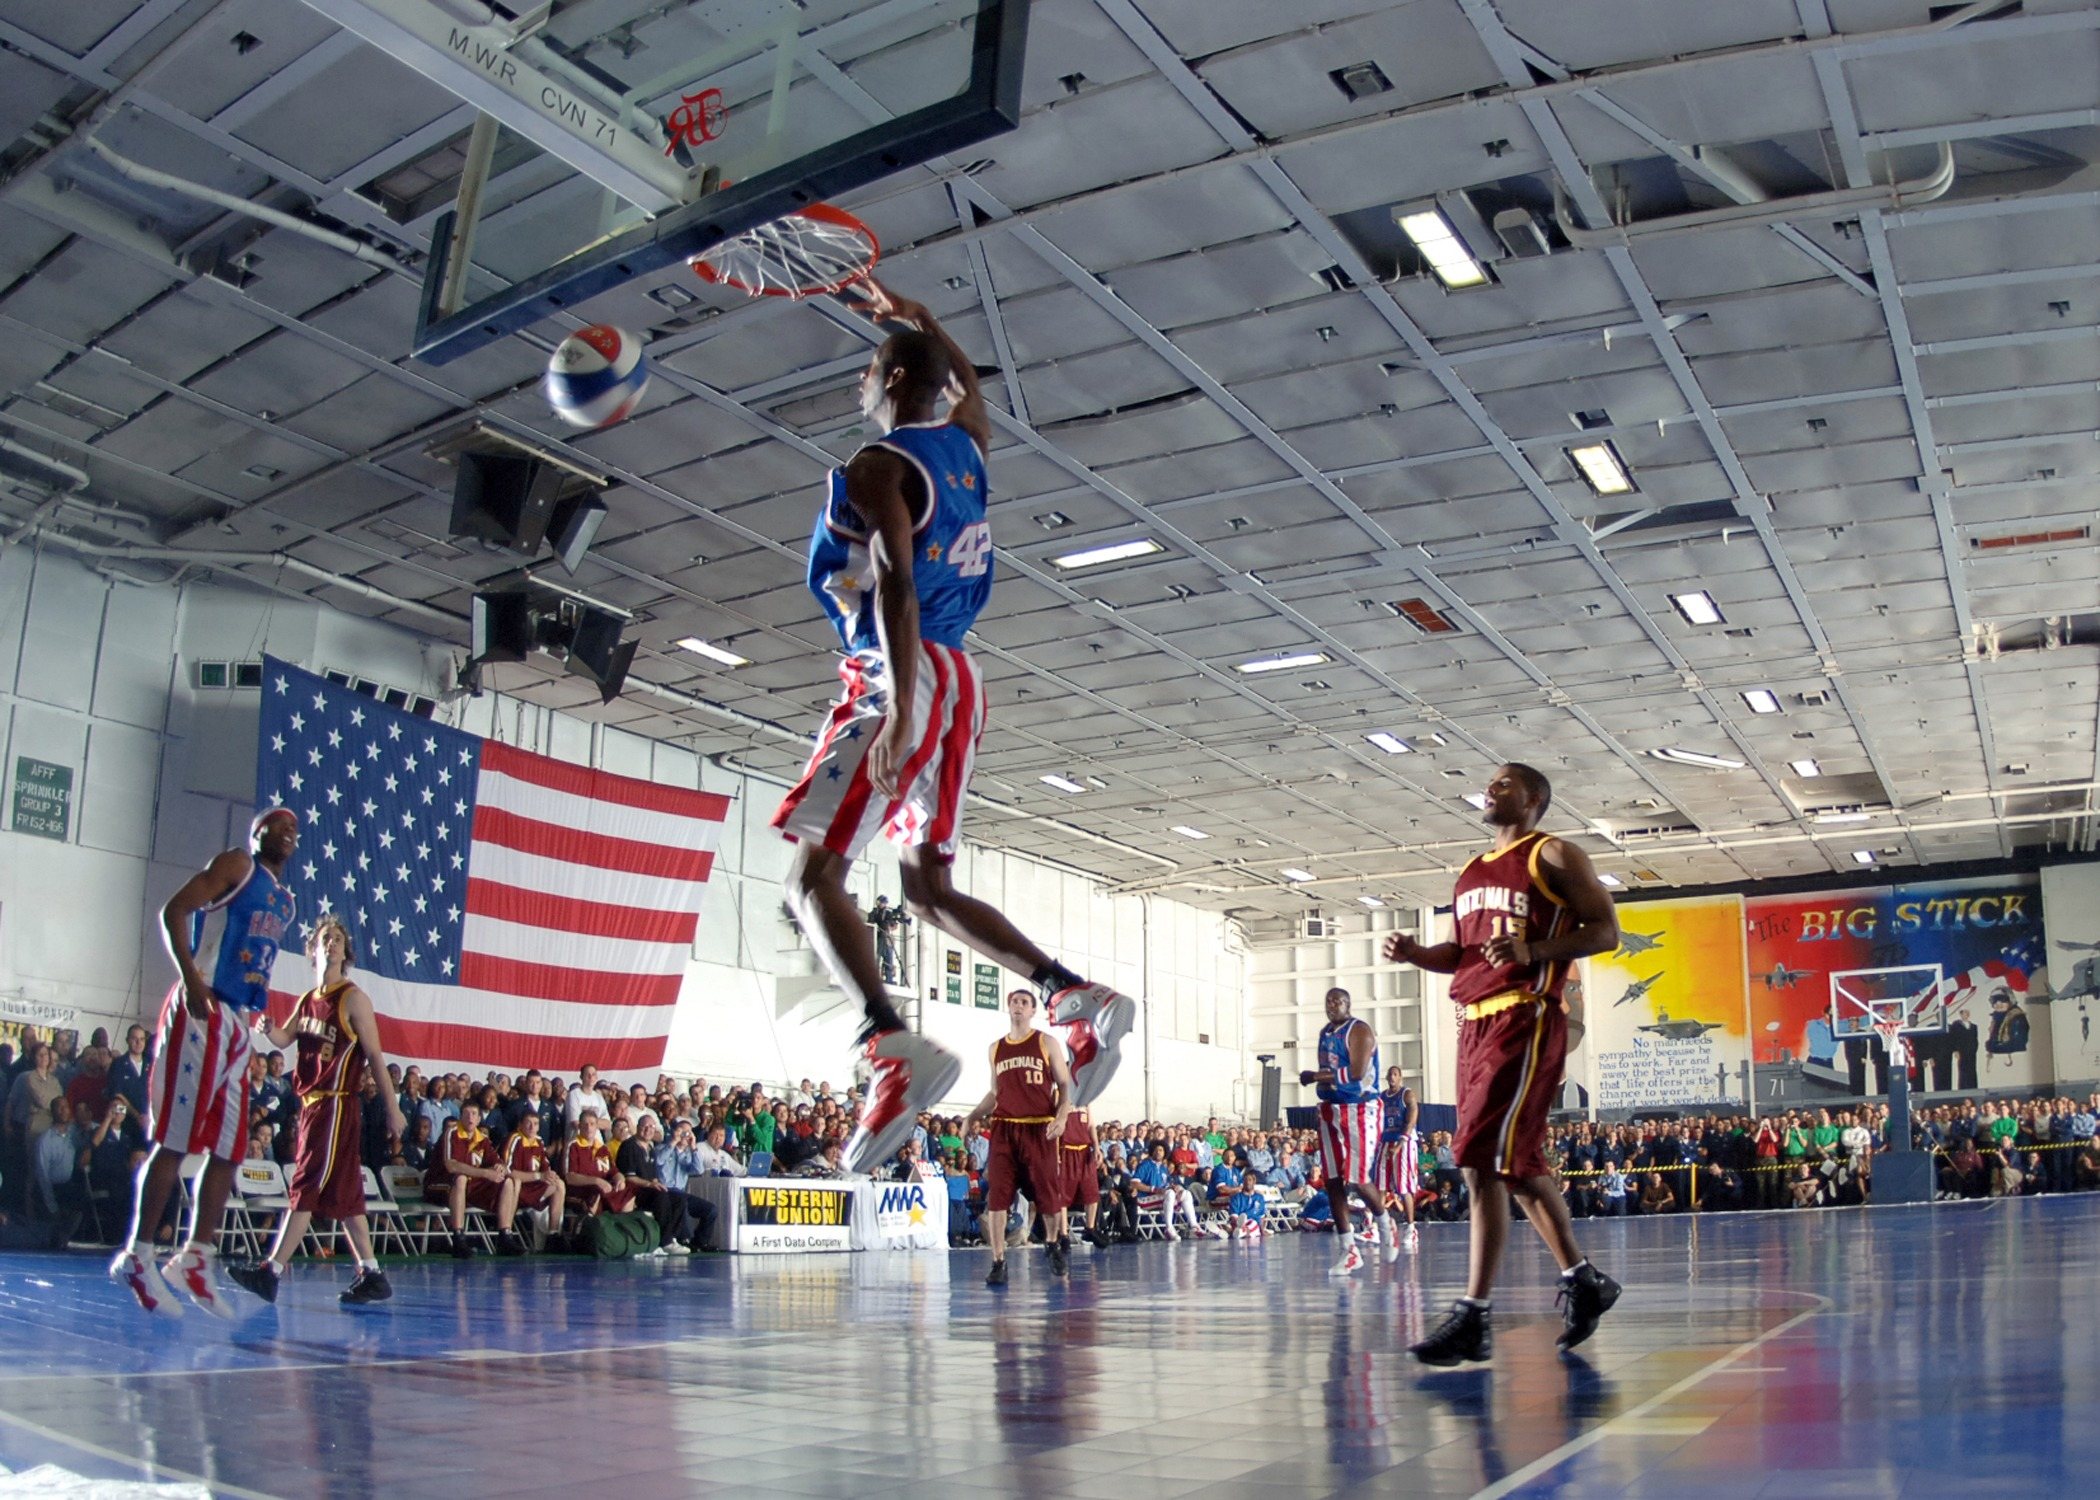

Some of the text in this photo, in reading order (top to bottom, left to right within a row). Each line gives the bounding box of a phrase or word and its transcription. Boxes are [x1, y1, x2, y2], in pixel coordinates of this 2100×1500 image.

[448, 28, 617, 146] M.W.R CVN 71
[947, 520, 992, 578] 42
[30, 764, 56, 779] AFFF
[21, 797, 62, 816] GROUP 3
[1754, 895, 2029, 942] The BIG STICK
[1491, 916, 1527, 944] 15
[1633, 1037, 1649, 1048] No
[1680, 1034, 1713, 1046] needs
[1599, 1046, 1711, 1062] sympathy because he
[1599, 1061, 1617, 1070] has
[1619, 1059, 1629, 1069] to
[1668, 1057, 1687, 1067] Far
[1690, 1056, 1710, 1065] and
[1025, 1070, 1044, 1085] 10
[1602, 1066, 1707, 1081] away the best prize
[1600, 1074, 1716, 1090] that life offers is the
[1770, 1078, 1785, 1096] 71
[1600, 1086, 1690, 1099] chance to work
[749, 1188, 835, 1208] WESTERN
[776, 1207, 835, 1225] UNION
[753, 1237, 842, 1249] A First Data Company
